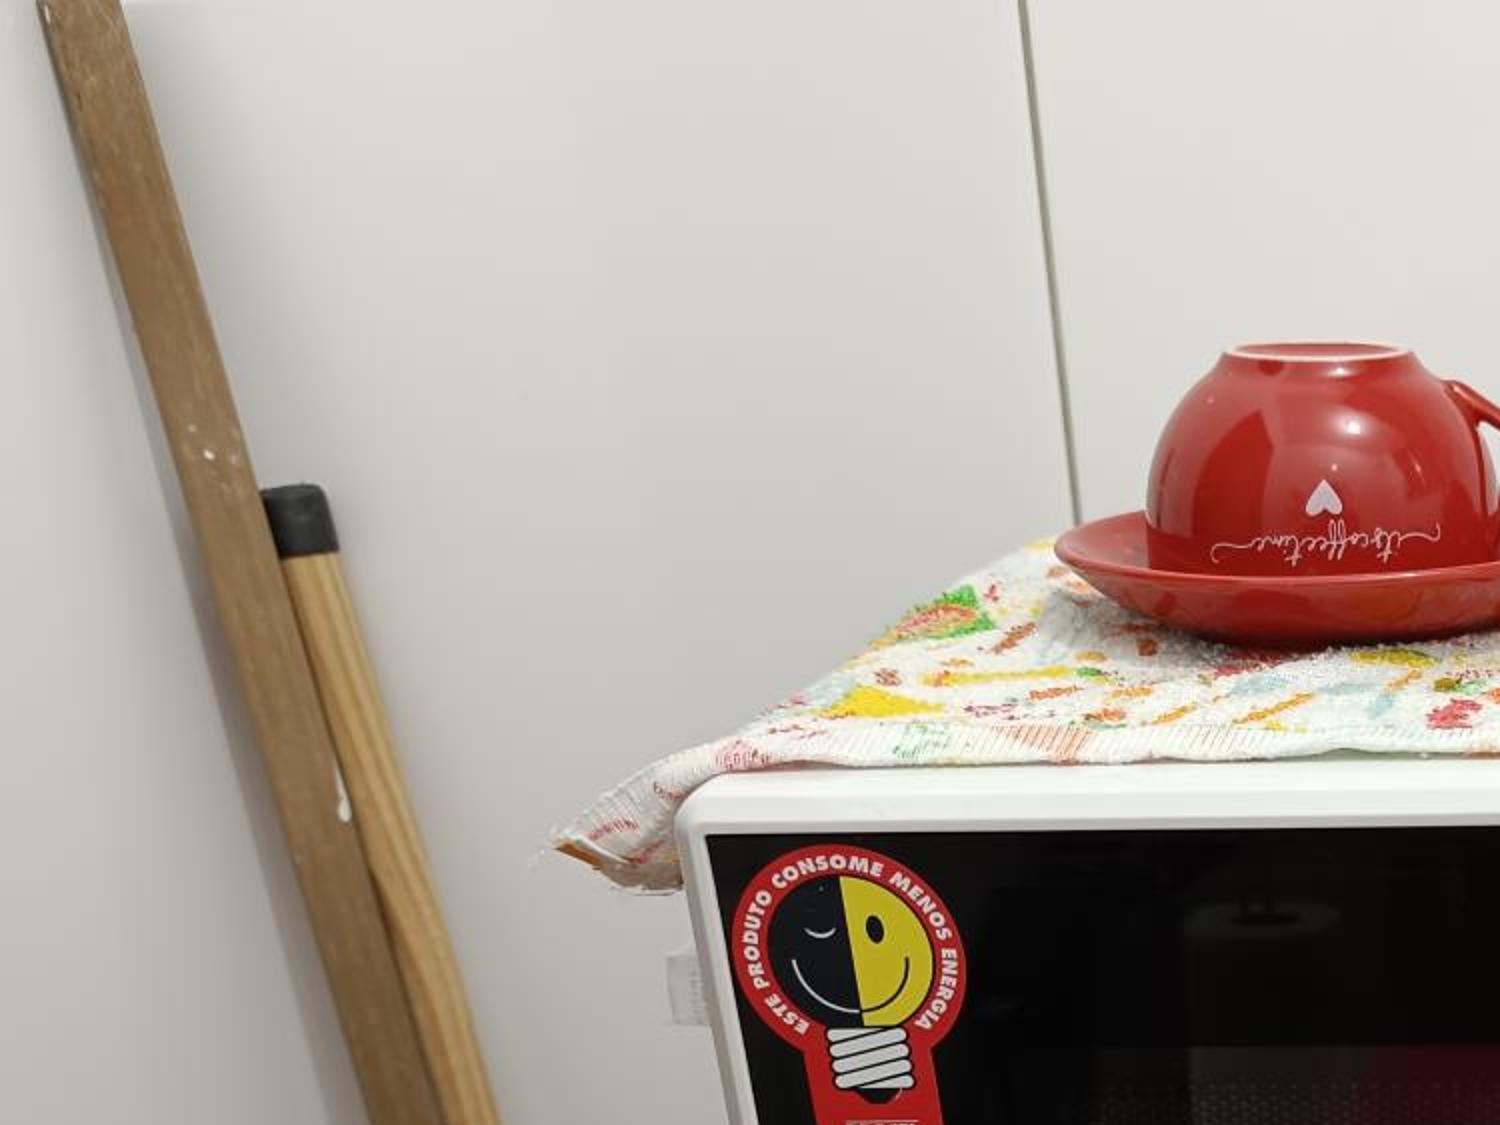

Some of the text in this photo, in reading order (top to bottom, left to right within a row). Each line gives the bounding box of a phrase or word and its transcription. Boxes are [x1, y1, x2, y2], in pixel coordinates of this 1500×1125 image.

[742, 854, 958, 1035] ESTE PRODUTO CONSOME MENOS ENERGIA
